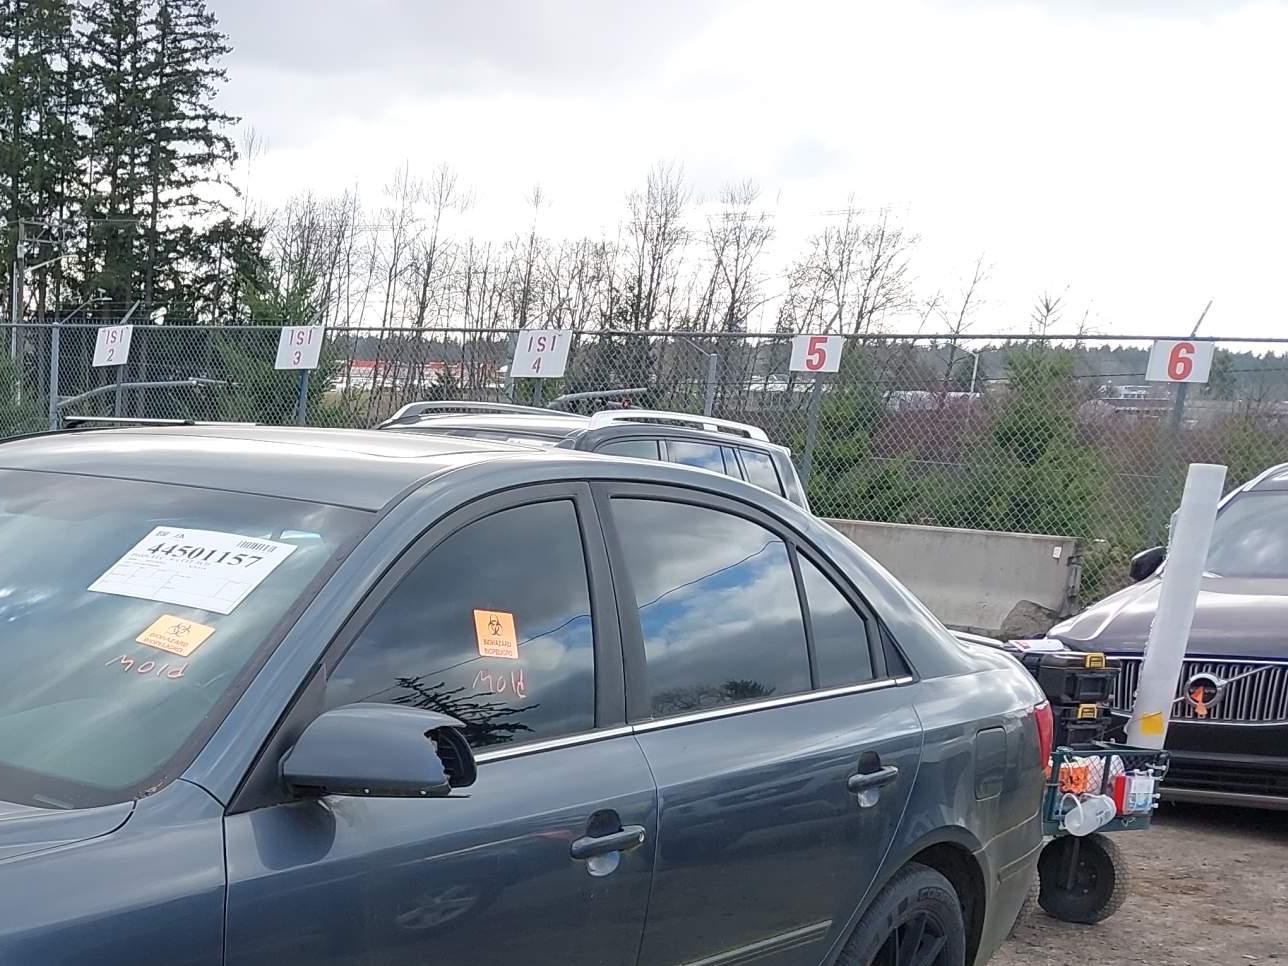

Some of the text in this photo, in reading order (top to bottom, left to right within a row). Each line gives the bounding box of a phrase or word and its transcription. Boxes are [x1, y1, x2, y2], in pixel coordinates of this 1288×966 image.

[106, 348, 114, 362] 2
[292, 351, 301, 365] 3
[805, 336, 829, 371] 5
[1167, 341, 1195, 381] 6
[530, 357, 541, 373] 4
[147, 542, 264, 569] 44501157
